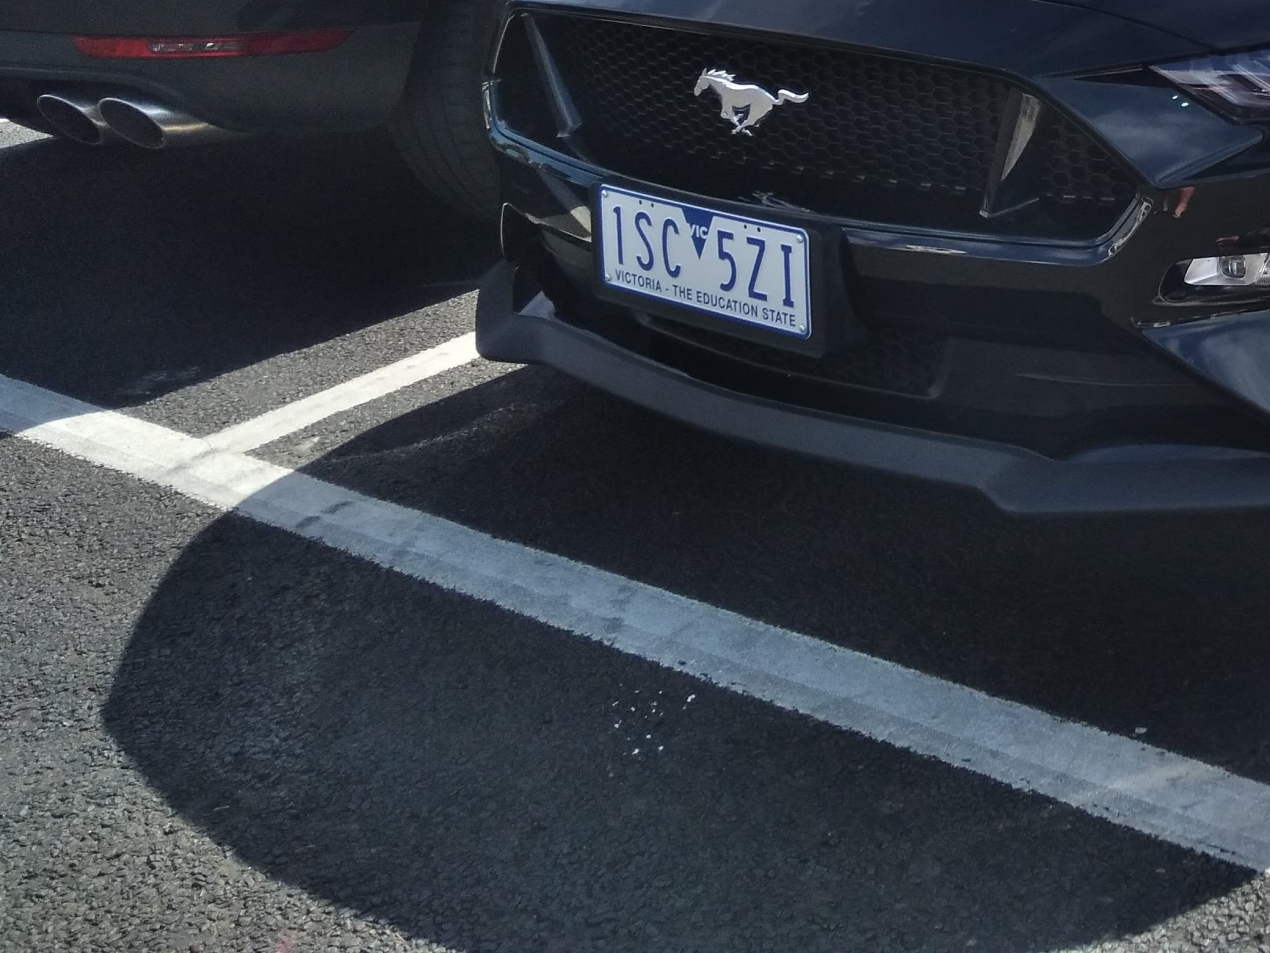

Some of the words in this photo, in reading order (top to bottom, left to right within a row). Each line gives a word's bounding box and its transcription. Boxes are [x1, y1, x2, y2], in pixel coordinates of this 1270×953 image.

[613, 205, 682, 278] 1SC
[716, 229, 795, 309] 5ZI
[615, 268, 662, 293] VICTORIA
[672, 283, 693, 301] THE
[696, 290, 759, 318] EDUCATION
[762, 307, 796, 328] STATE
